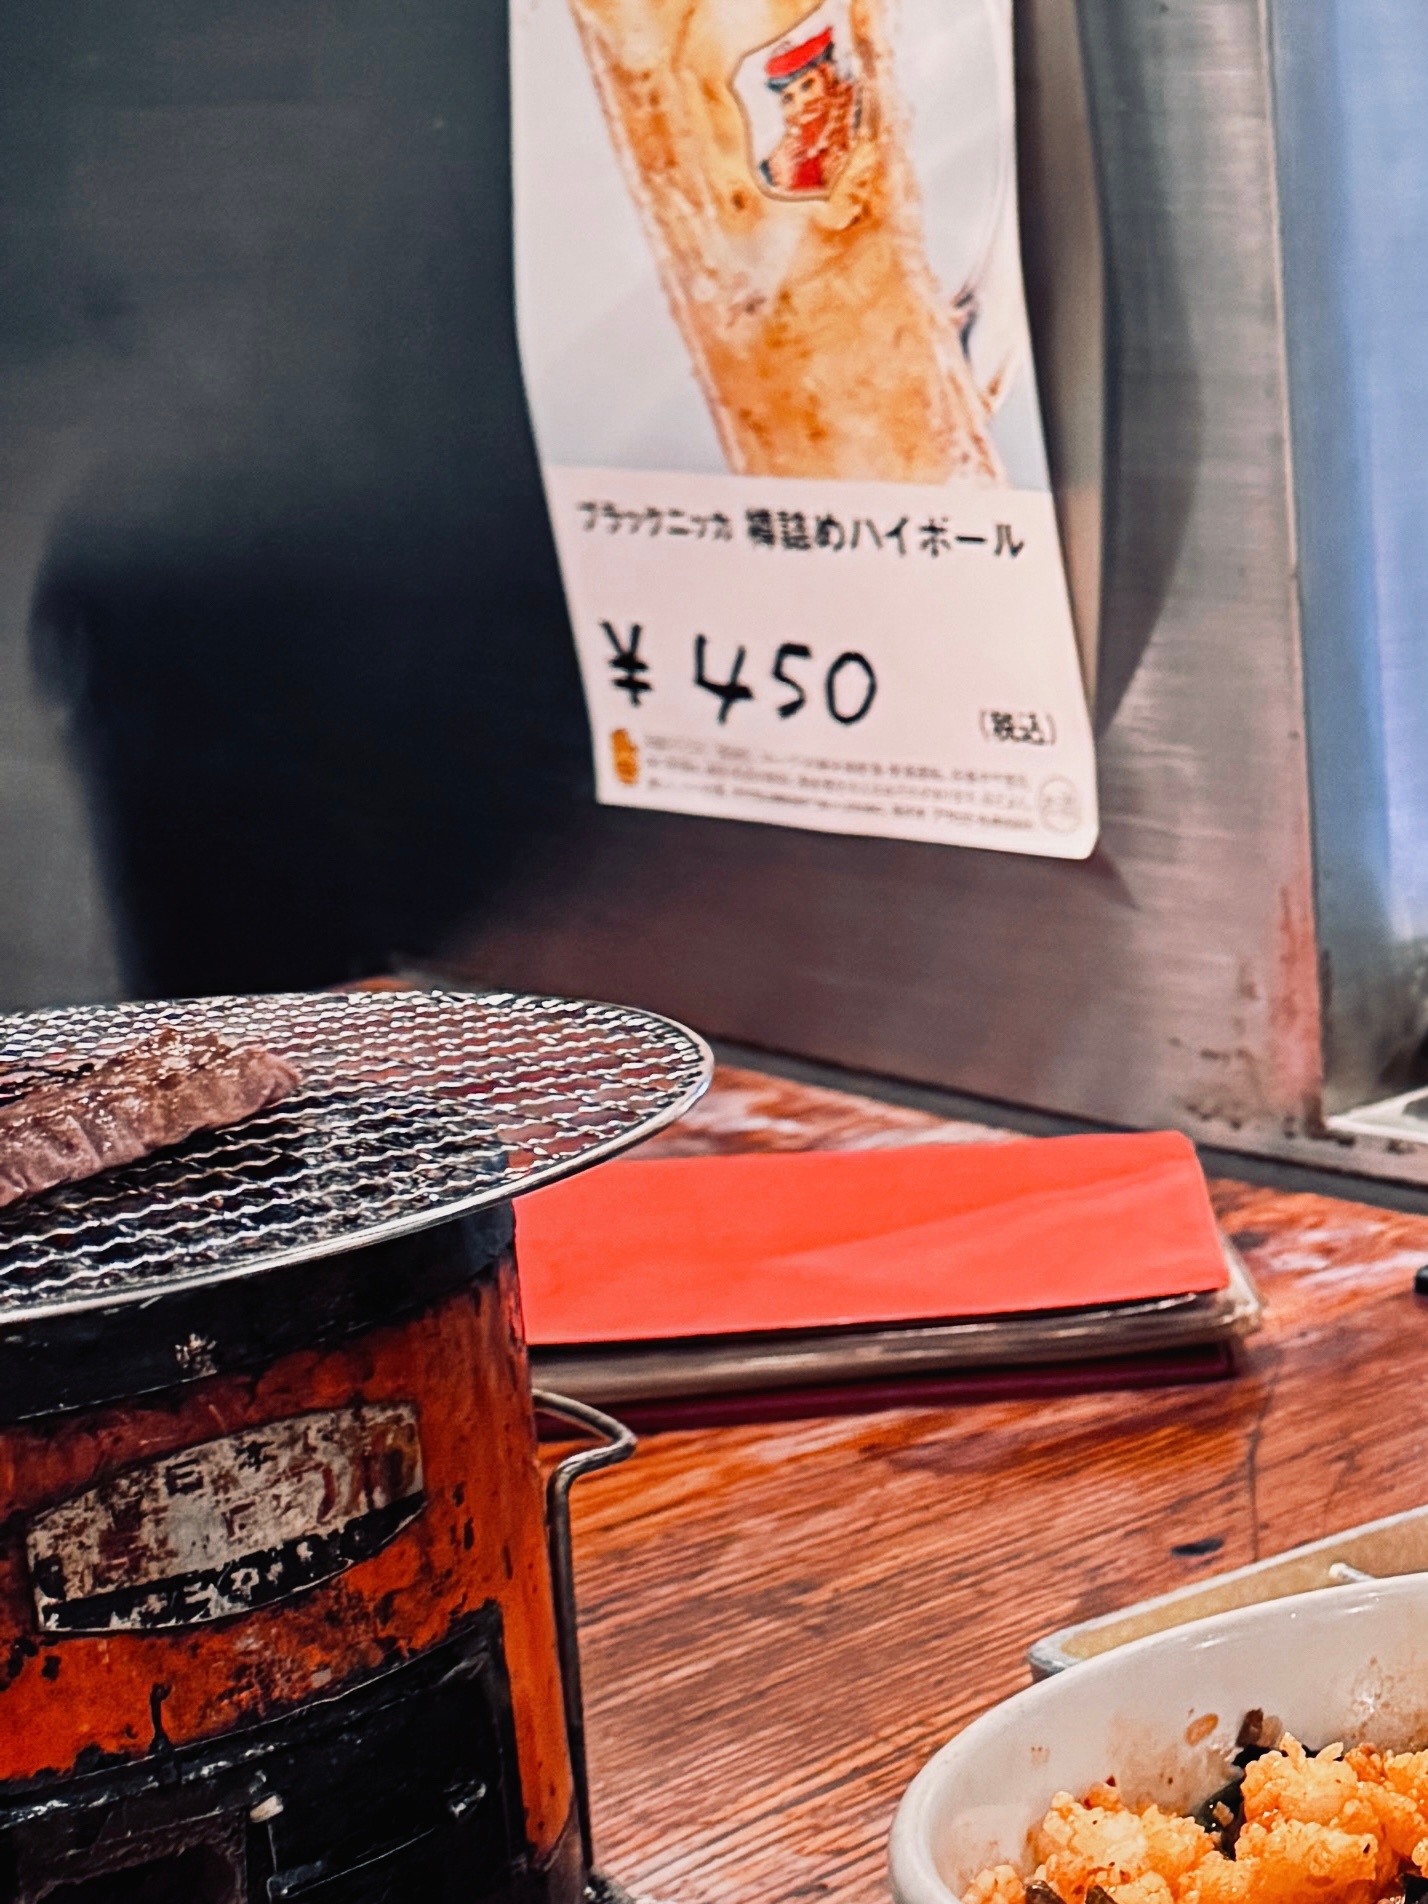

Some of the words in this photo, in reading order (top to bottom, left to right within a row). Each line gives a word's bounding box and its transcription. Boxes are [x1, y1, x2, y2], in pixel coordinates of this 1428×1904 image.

[577, 500, 734, 543] ブラックニッカ
